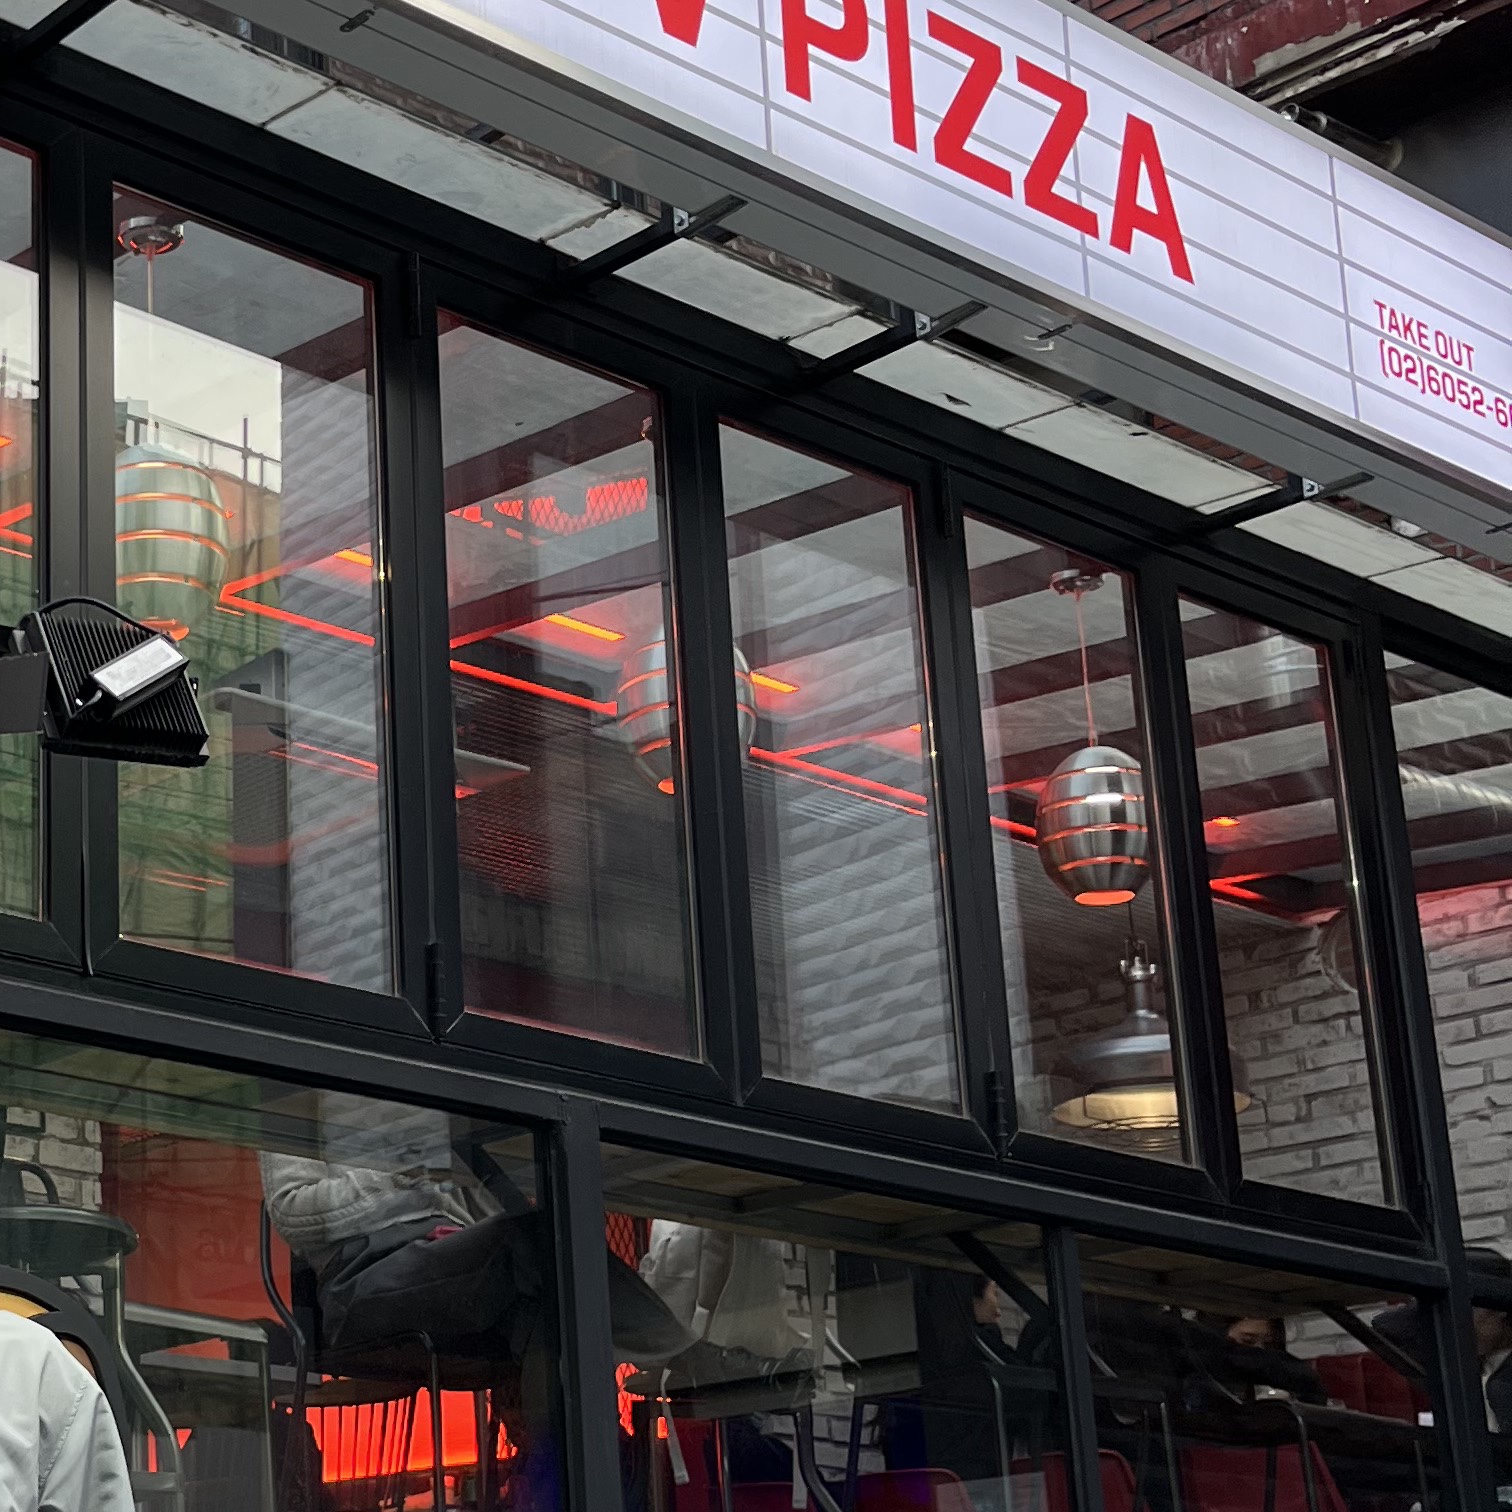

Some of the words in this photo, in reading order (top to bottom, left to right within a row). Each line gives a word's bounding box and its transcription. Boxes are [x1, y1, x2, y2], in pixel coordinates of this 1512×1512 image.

[781, 0, 1195, 286] PIZZA
[1372, 298, 1431, 353] TAKE
[1434, 329, 1475, 372] OUT
[1379, 338, 1512, 428] (02)6052-6
